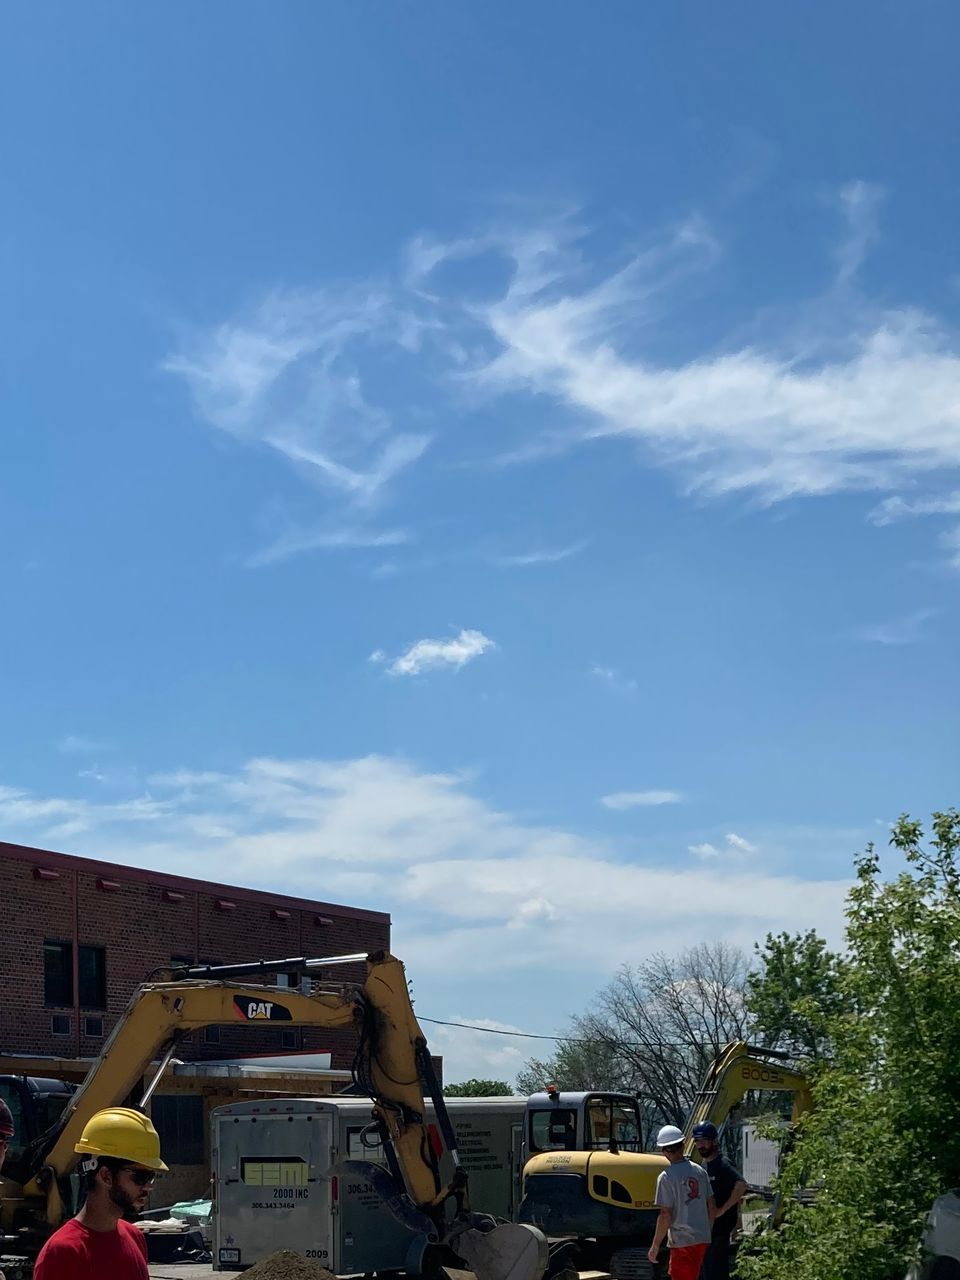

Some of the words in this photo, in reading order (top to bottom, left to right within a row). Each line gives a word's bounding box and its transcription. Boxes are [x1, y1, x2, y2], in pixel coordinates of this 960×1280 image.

[247, 1003, 273, 1018] CAT
[273, 1188, 293, 1199] 2000
[295, 1188, 309, 1199] INC
[305, 1249, 329, 1259] 2009
